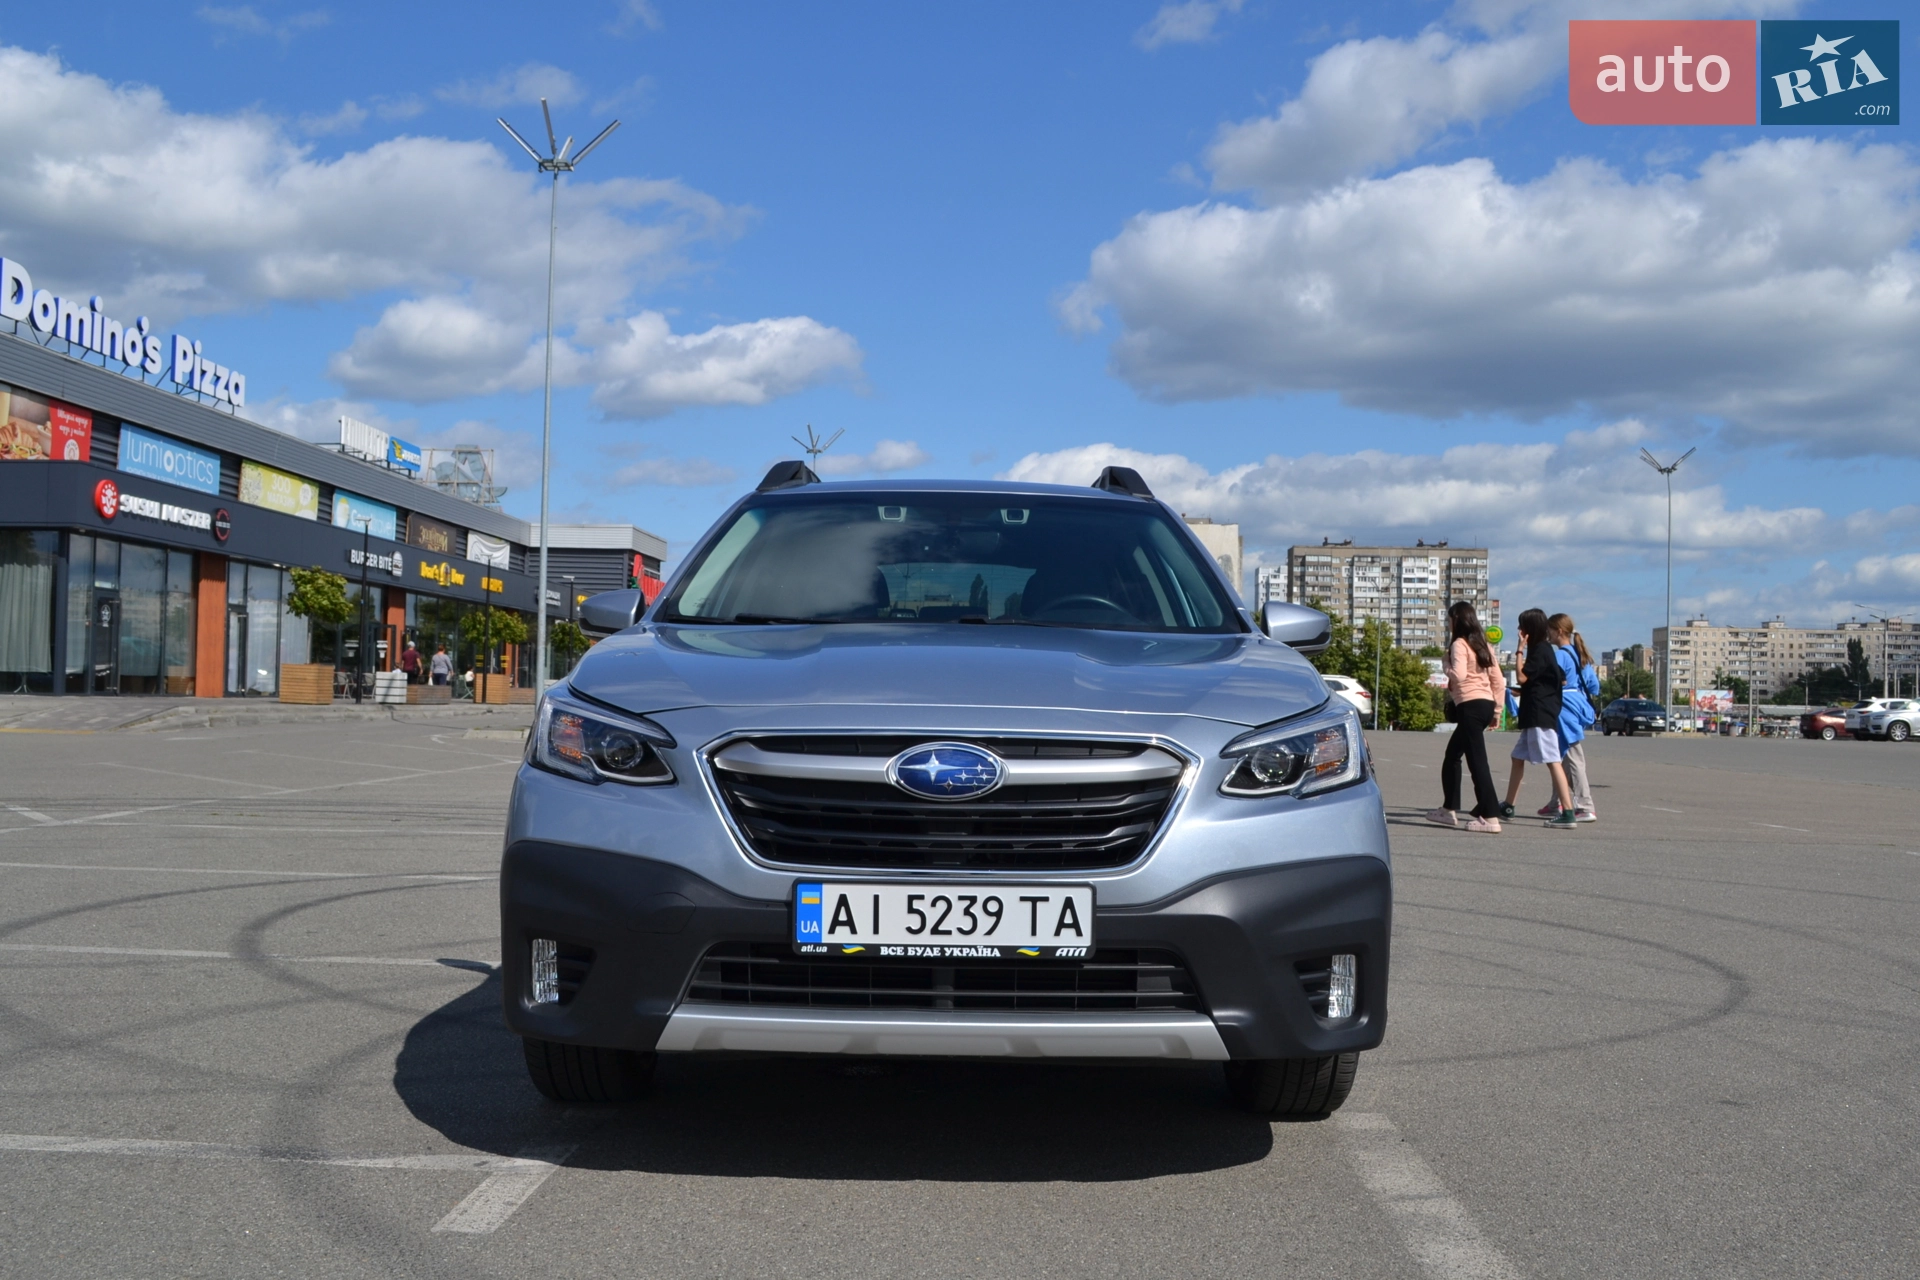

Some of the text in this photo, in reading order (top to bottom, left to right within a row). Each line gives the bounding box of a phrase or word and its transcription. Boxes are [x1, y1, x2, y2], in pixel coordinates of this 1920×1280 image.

[0, 257, 245, 407] Domino's Pizza
[126, 427, 214, 485] lumioptics
[119, 494, 212, 530] SUSHI MASTER
[800, 920, 820, 934] UA
[827, 893, 1084, 937] AI 5239 TA
[800, 944, 828, 953] atl.ua
[880, 946, 1001, 957] ВСЕ БУДЕ УКРАЇНА
